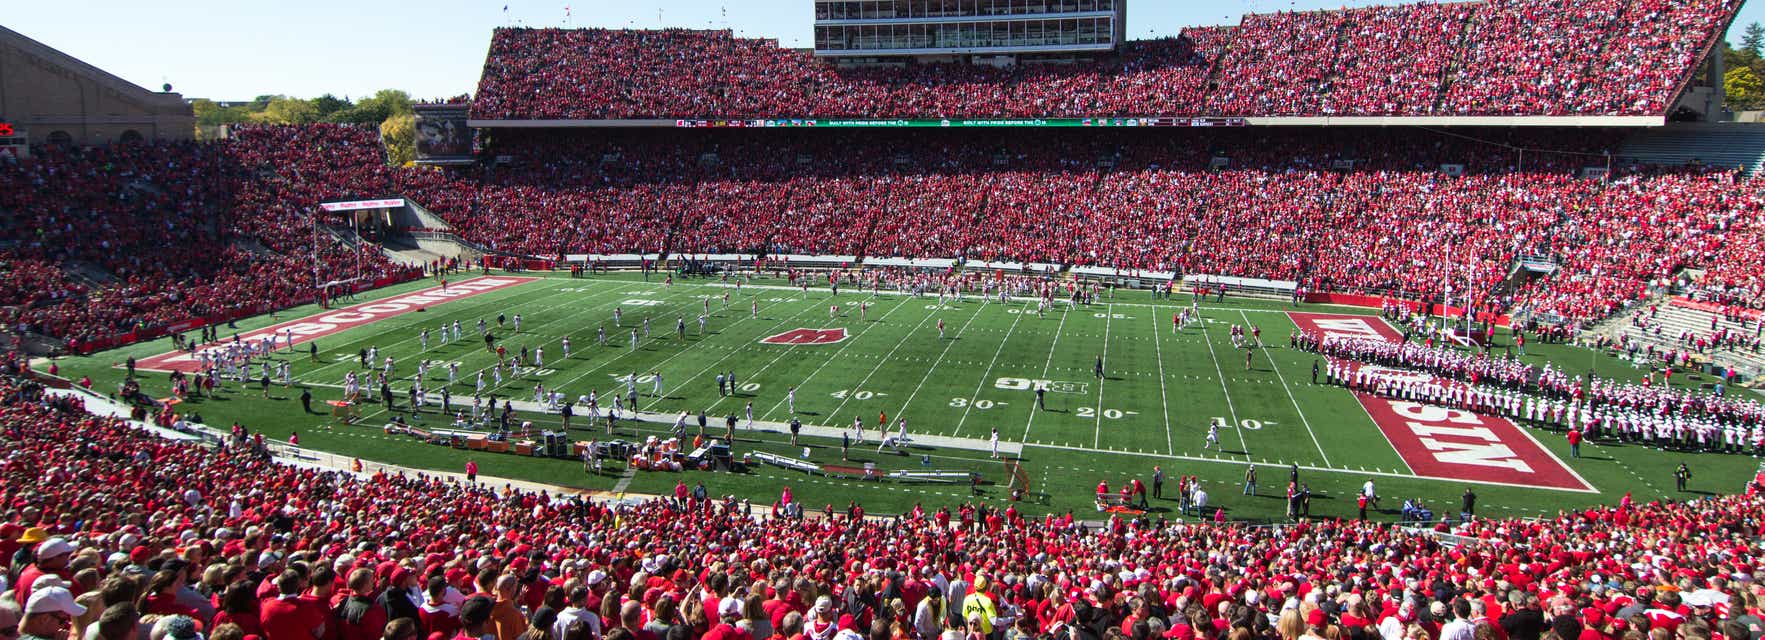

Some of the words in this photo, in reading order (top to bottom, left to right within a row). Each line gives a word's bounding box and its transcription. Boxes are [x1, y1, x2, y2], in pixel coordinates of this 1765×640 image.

[830, 390, 875, 401] 40
[949, 397, 993, 410] 30
[1076, 406, 1123, 420] 20
[1211, 416, 1262, 430] 10
